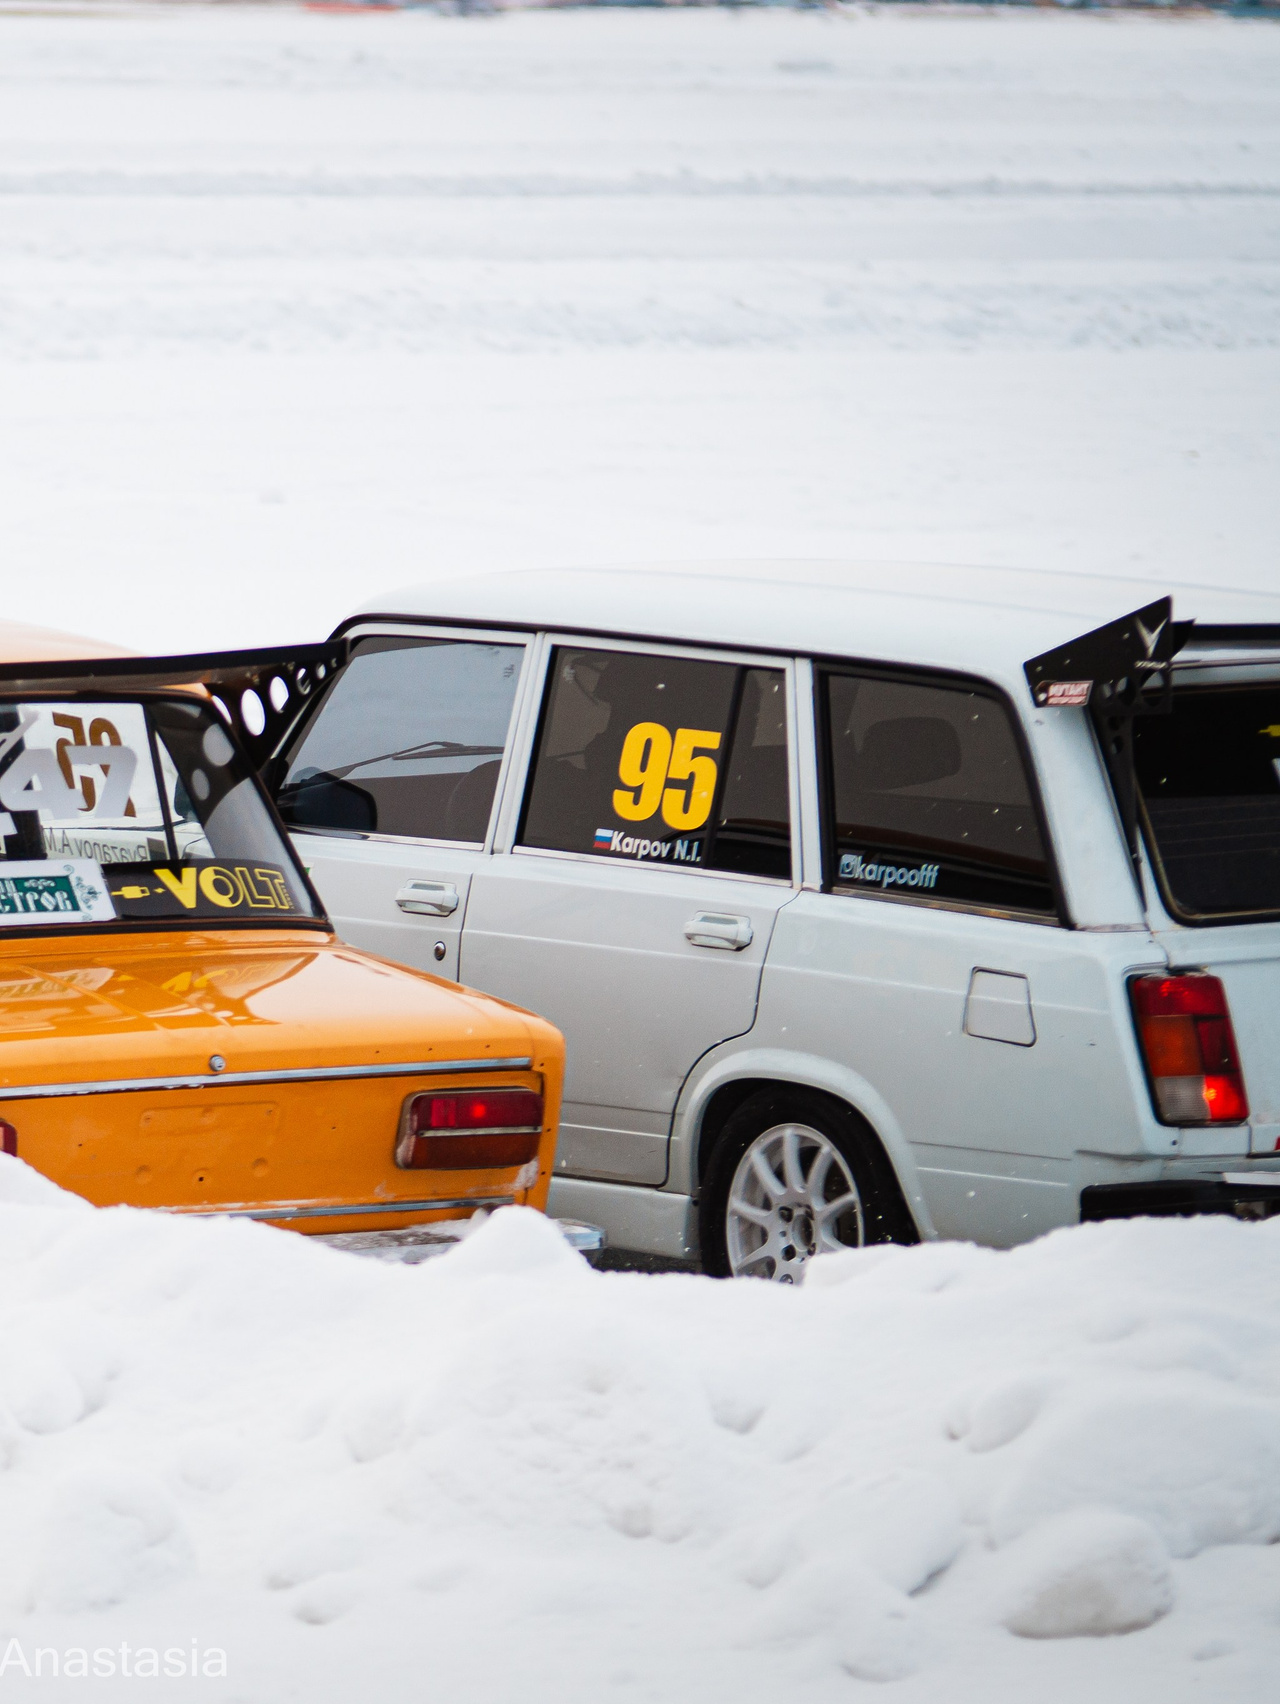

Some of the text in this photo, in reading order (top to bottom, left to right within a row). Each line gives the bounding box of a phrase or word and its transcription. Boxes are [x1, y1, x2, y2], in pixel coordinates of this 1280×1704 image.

[612, 721, 722, 831] 95
[610, 831, 702, 862] Karpov N.I.
[153, 866, 290, 909] VOLT
